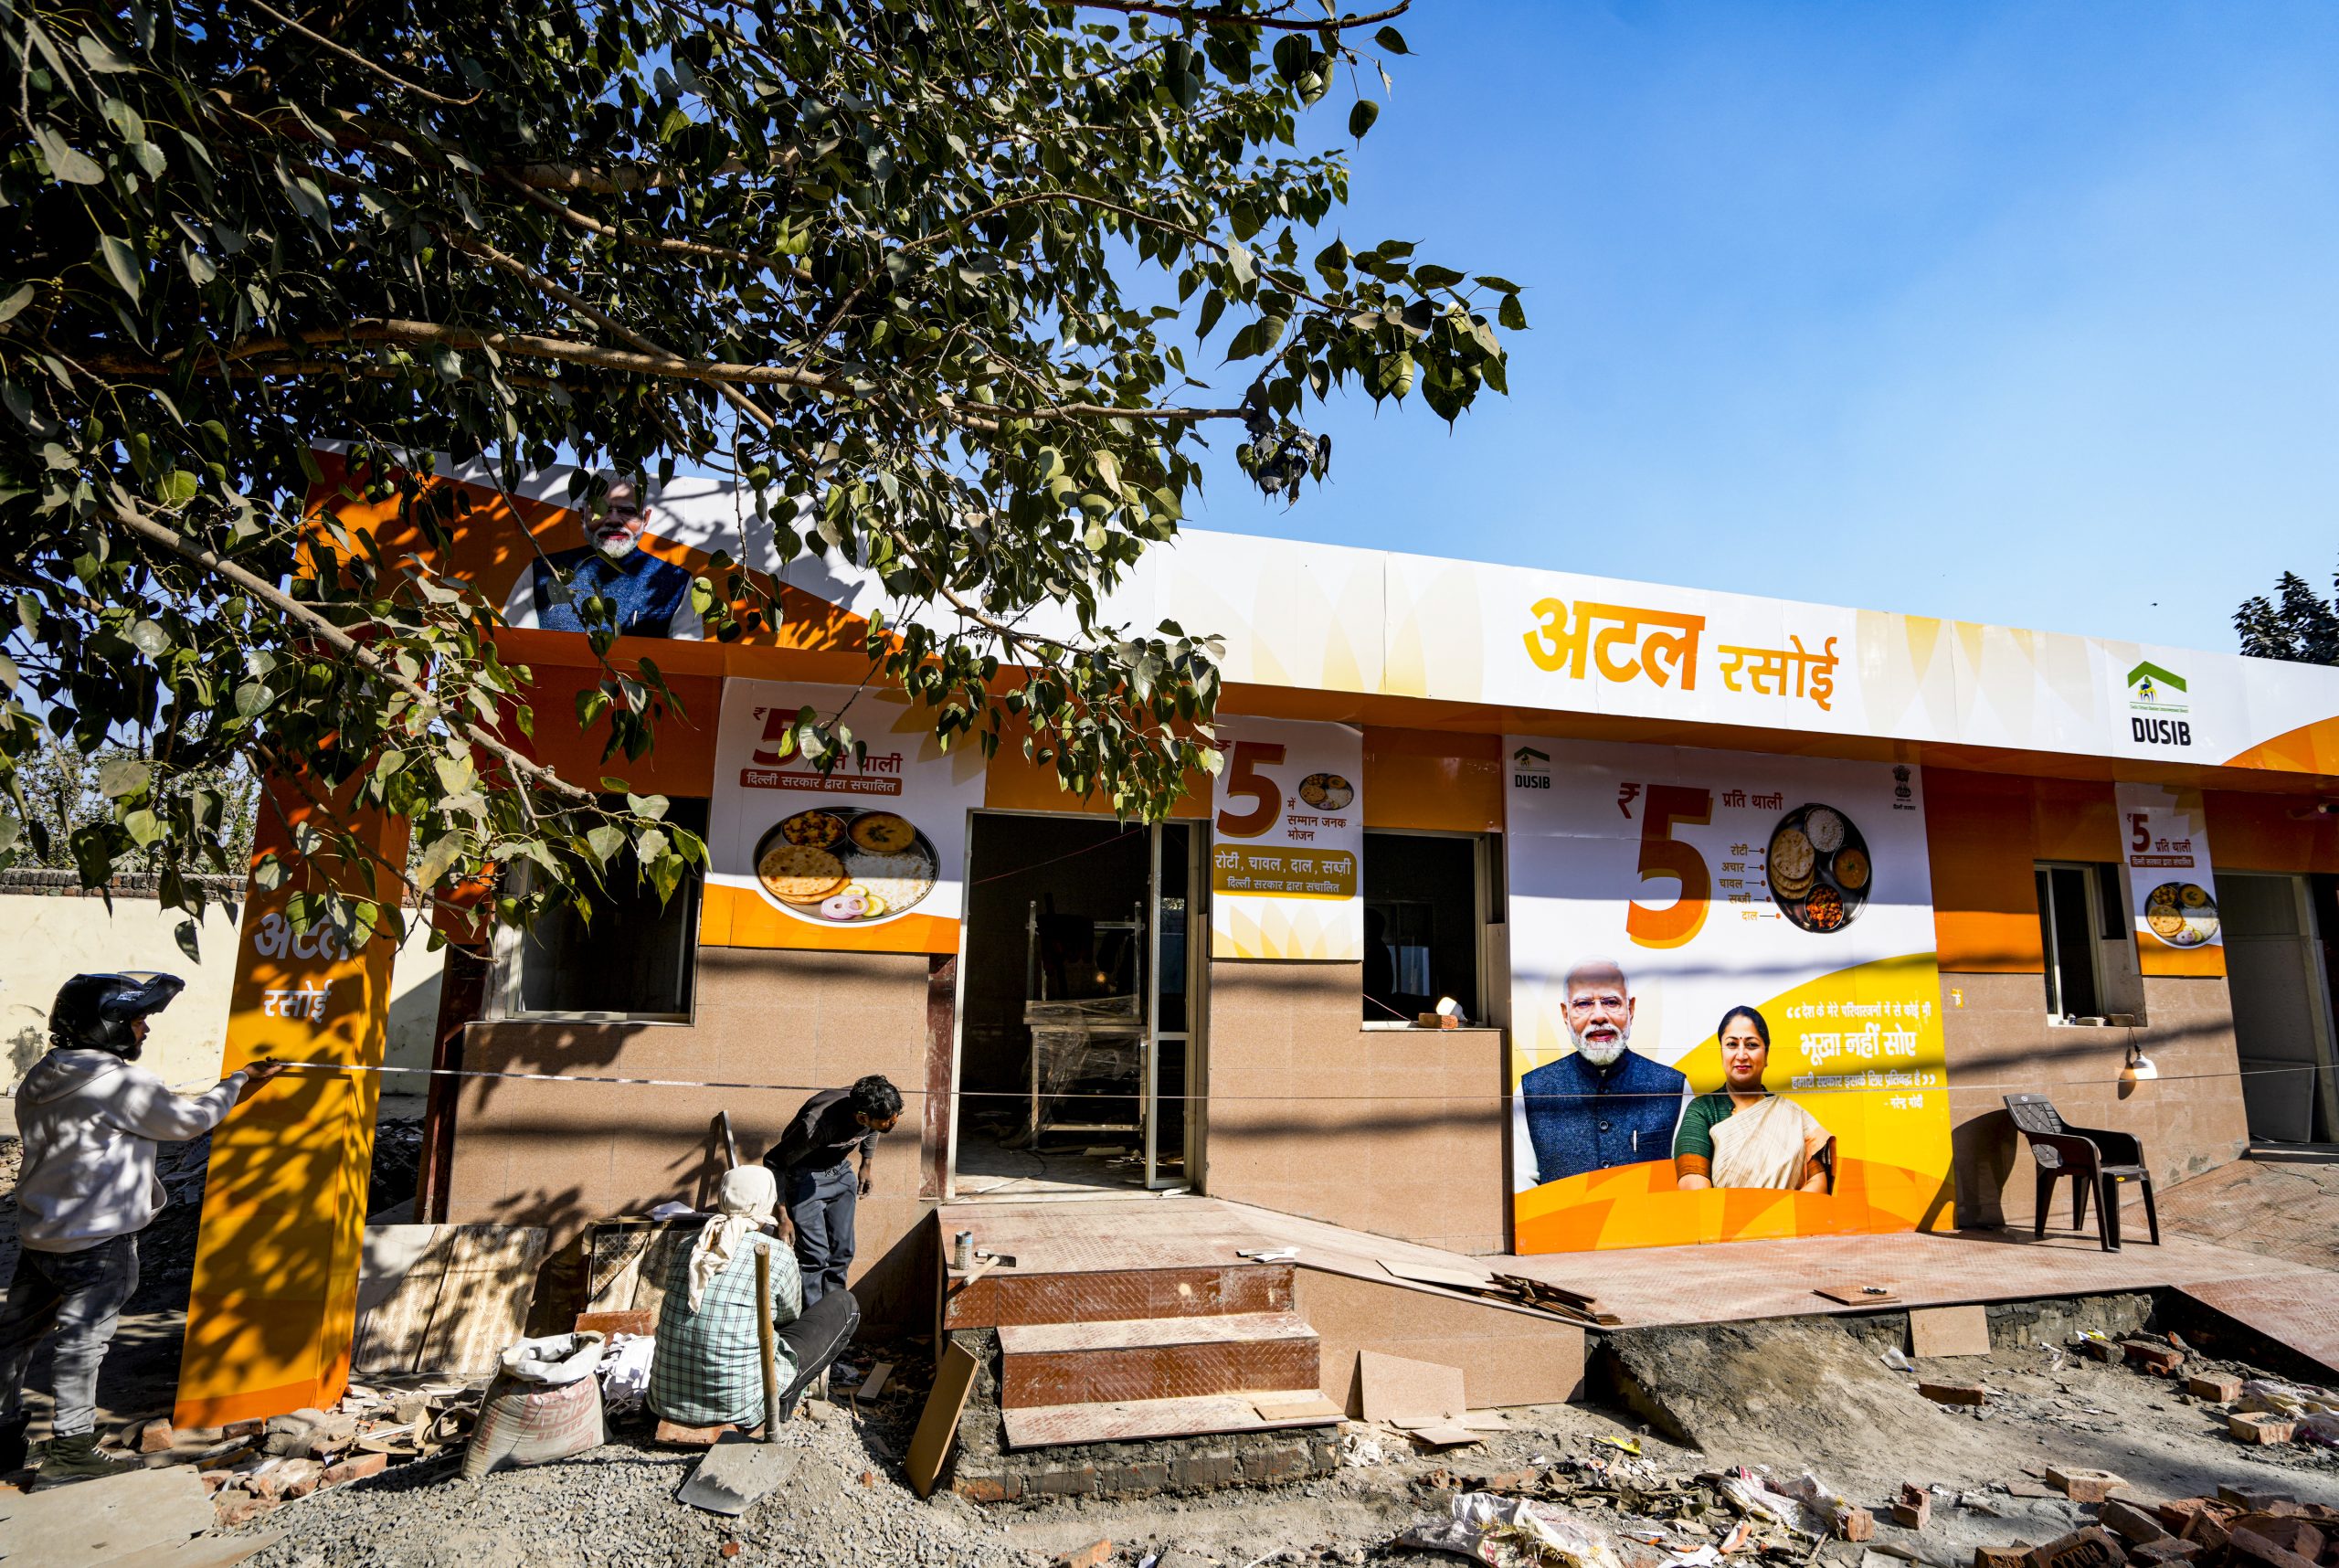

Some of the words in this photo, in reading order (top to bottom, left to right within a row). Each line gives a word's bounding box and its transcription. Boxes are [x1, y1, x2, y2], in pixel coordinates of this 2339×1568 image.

[1522, 597, 1706, 691] अटल
[1717, 634, 1839, 712] रसोई
[2132, 717, 2191, 746] DUSIB
[746, 772, 778, 786] दिल्ली
[781, 776, 820, 789] सरकार
[824, 779, 847, 790] द्वारा
[851, 779, 896, 792] संचालित
[1515, 774, 1551, 789] DUSIB
[1287, 797, 1296, 810] में
[1722, 789, 1747, 809] प्रति
[1752, 792, 1783, 810] थाली
[1287, 815, 1318, 827] सम्मान
[1321, 817, 1347, 829] जनक
[1287, 828, 1315, 841] भोजन
[1730, 843, 1749, 856] रोटी
[2155, 838, 2169, 853] प्रति
[2172, 839, 2191, 853] थाली
[1721, 862, 1745, 873] अचार
[1227, 875, 1251, 888] दिल्ली
[1254, 878, 1283, 890] सरकार
[1286, 881, 1303, 892] द्वारा
[1306, 880, 1340, 893] संचालित
[1719, 878, 1743, 889] चावल
[1741, 911, 1759, 921] दाल
[264, 979, 333, 1023] रसोई
[1800, 1032, 1841, 1066] भूखा
[1845, 1022, 1880, 1058] नहीं
[1882, 1022, 1916, 1056] सोए
